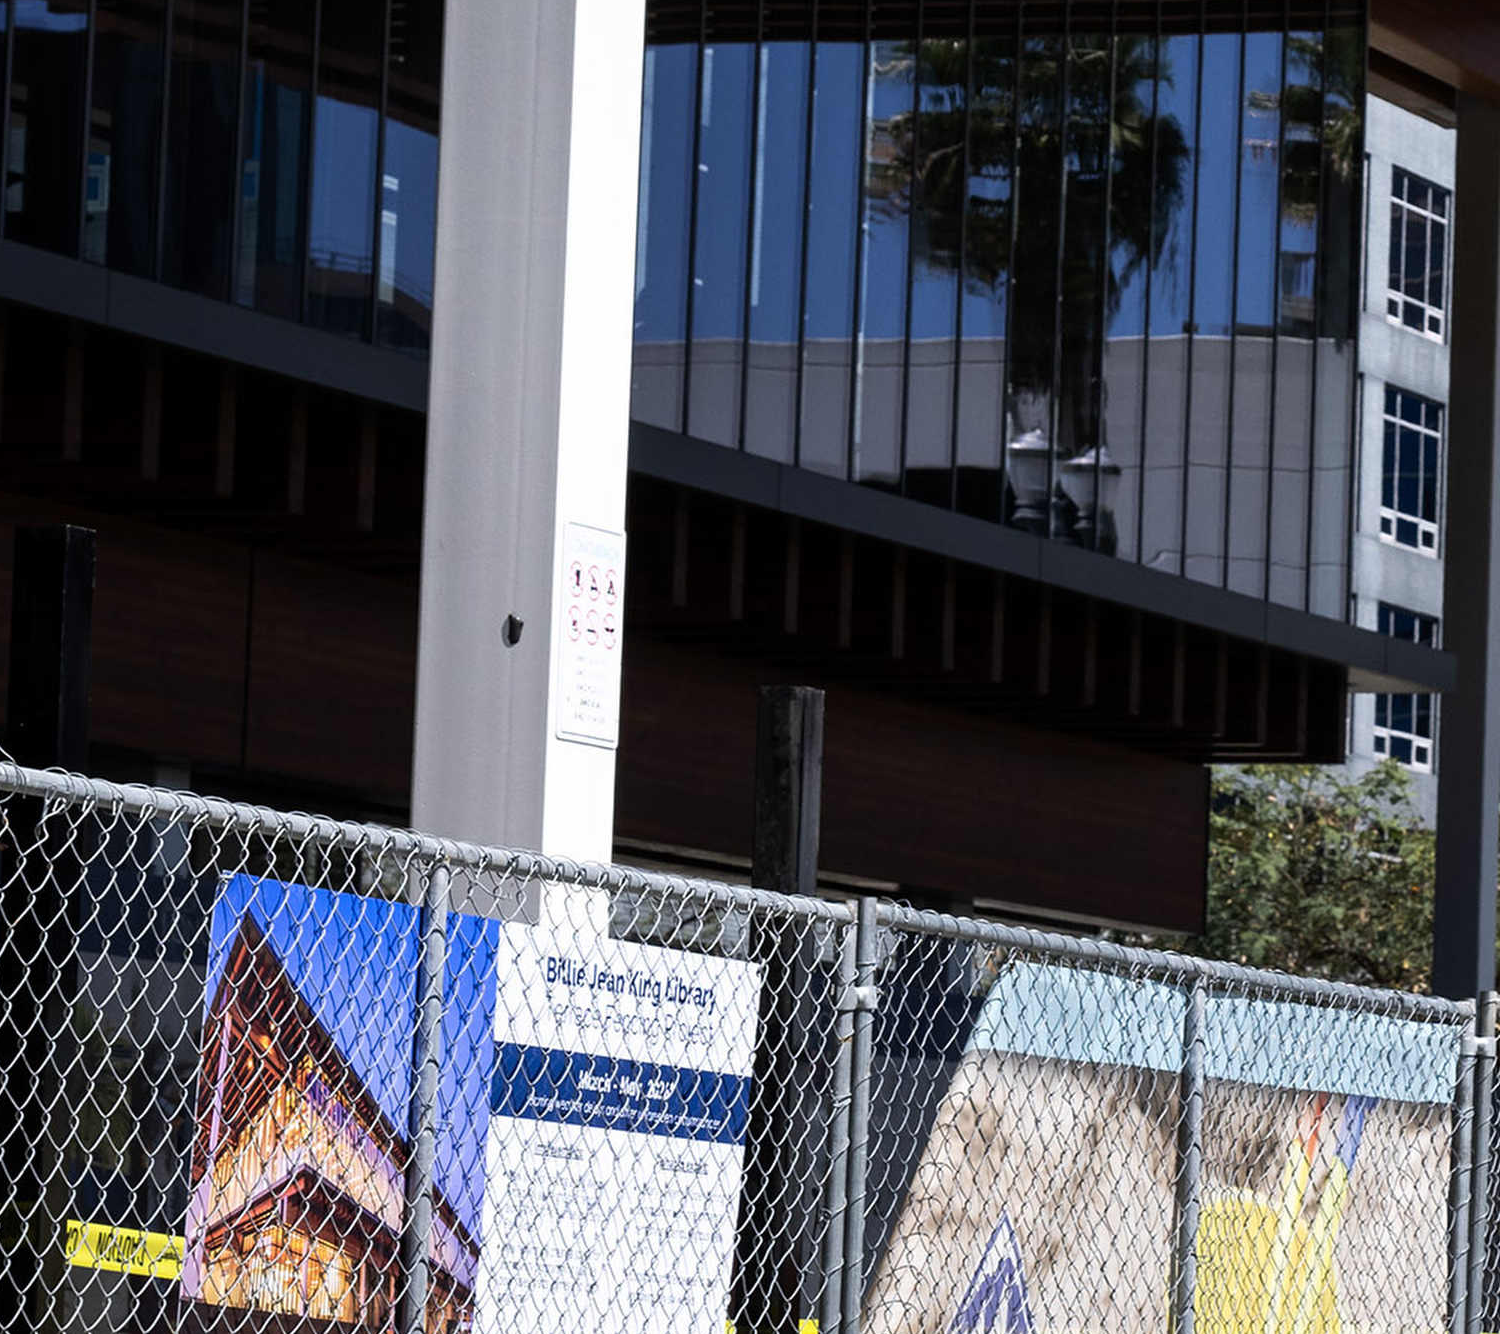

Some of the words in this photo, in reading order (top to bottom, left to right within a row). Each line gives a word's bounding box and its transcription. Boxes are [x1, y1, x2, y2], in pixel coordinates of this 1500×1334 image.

[547, 956, 586, 988] Billie
[589, 964, 624, 996] Jean
[629, 970, 661, 1007] King
[664, 977, 716, 1015] Library
